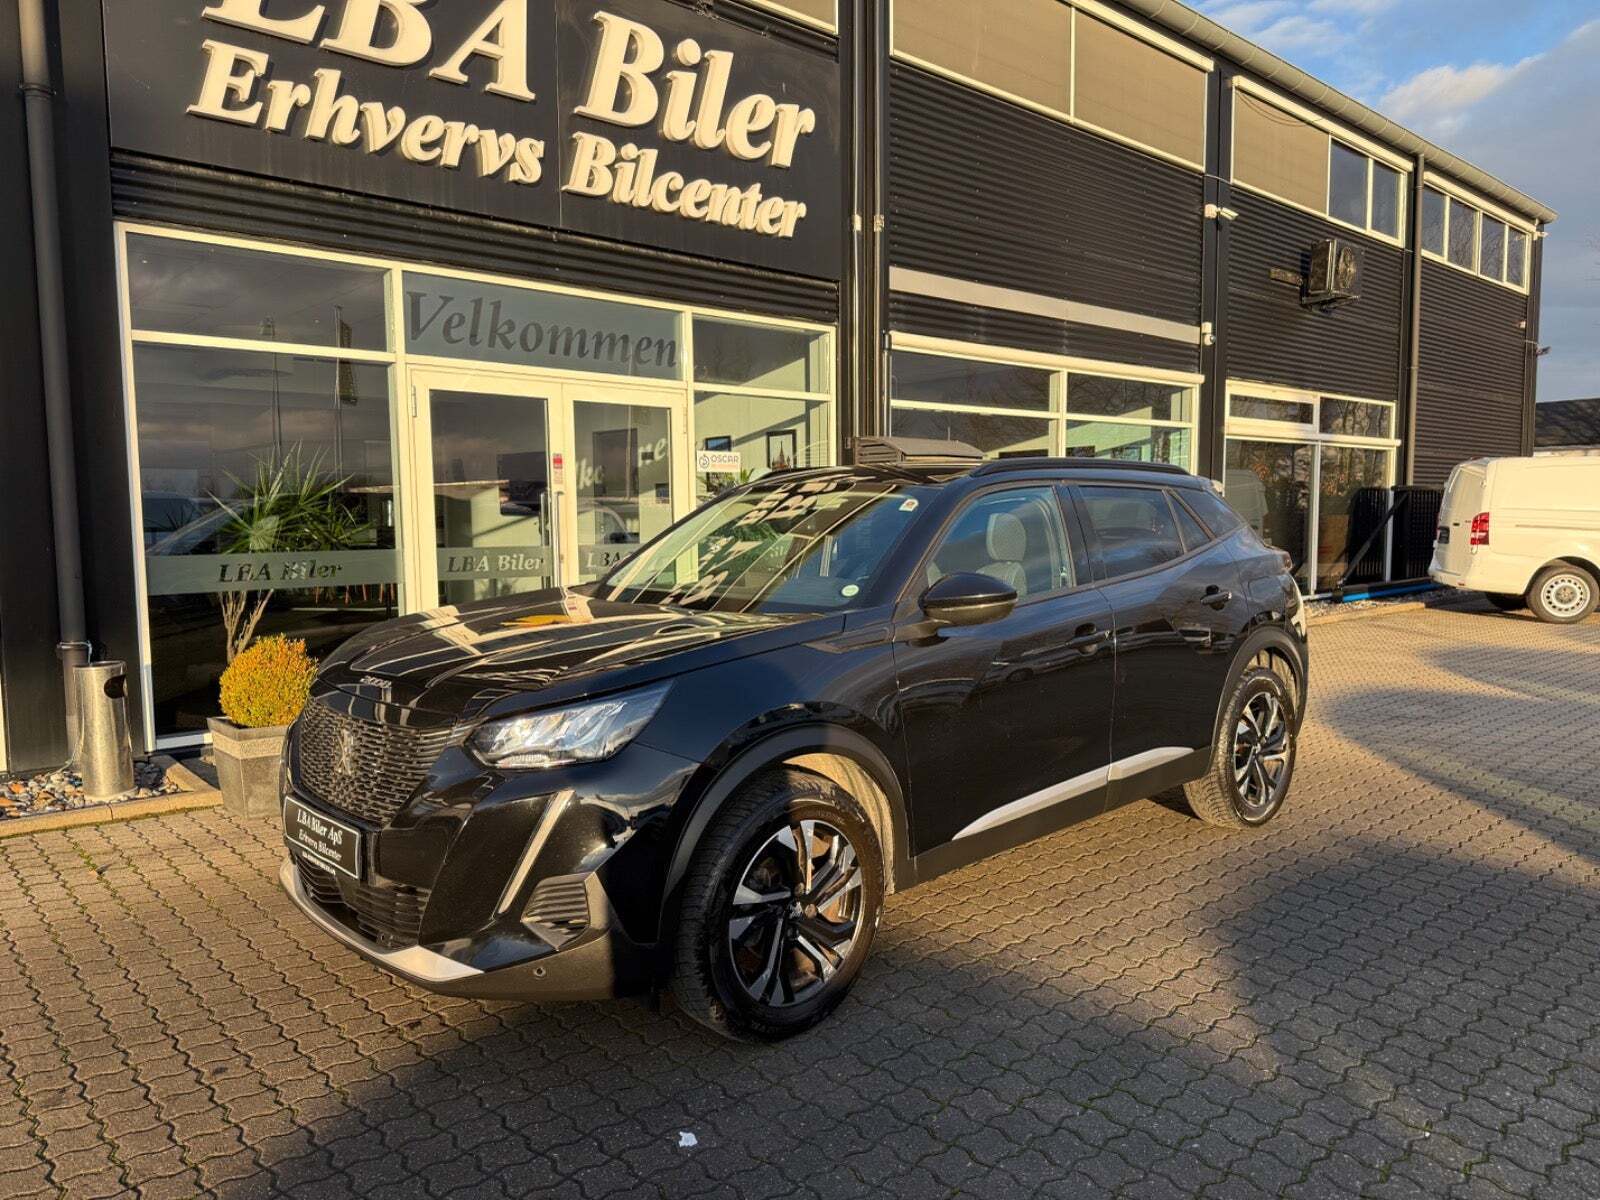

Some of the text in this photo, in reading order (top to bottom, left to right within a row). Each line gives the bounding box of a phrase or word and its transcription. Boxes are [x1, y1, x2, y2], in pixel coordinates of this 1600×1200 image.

[574, 10, 816, 168] Biler
[186, 39, 807, 237] Erhvervs Bilcenter
[407, 291, 677, 368] Velkommen
[711, 454, 739, 463] OSCAR
[218, 559, 343, 582] LBA Biler
[447, 552, 546, 573] LBA Biler
[297, 809, 343, 846] LBA Biler ApS
